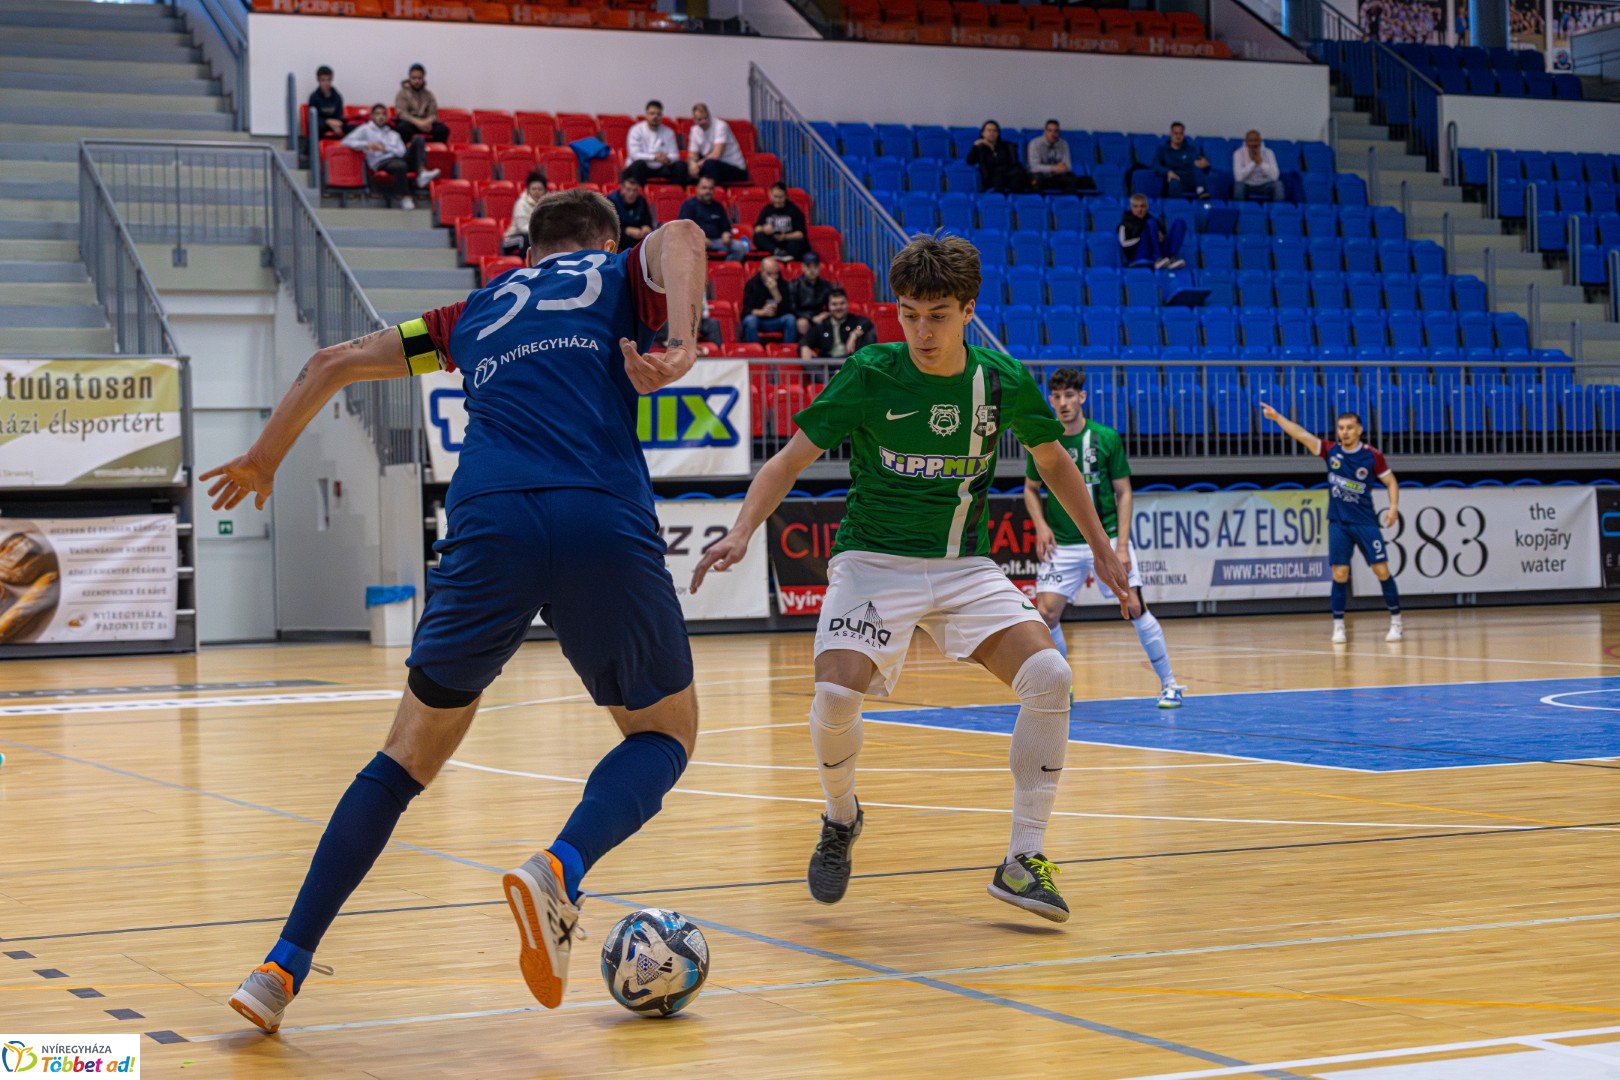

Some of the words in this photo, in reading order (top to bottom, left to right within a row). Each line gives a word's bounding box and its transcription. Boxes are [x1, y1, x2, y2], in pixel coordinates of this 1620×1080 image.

[476, 253, 607, 341] 53
[500, 334, 599, 366] NYÍREGYHÁZA
[0, 372, 153, 401] tudatosan
[49, 409, 165, 442] élsportért
[1529, 502, 1556, 521] the
[1130, 511, 1210, 551] CIENS
[1217, 510, 1246, 548] AZ
[1255, 499, 1322, 547] ELSŐ!
[1372, 539, 1382, 554] 9
[1376, 506, 1489, 578] 383
[1222, 562, 1323, 580] WWW.FMEDICAL.HU
[1521, 557, 1566, 573] water
[781, 591, 825, 611] Nyír
[833, 630, 882, 649] ASZFALT
